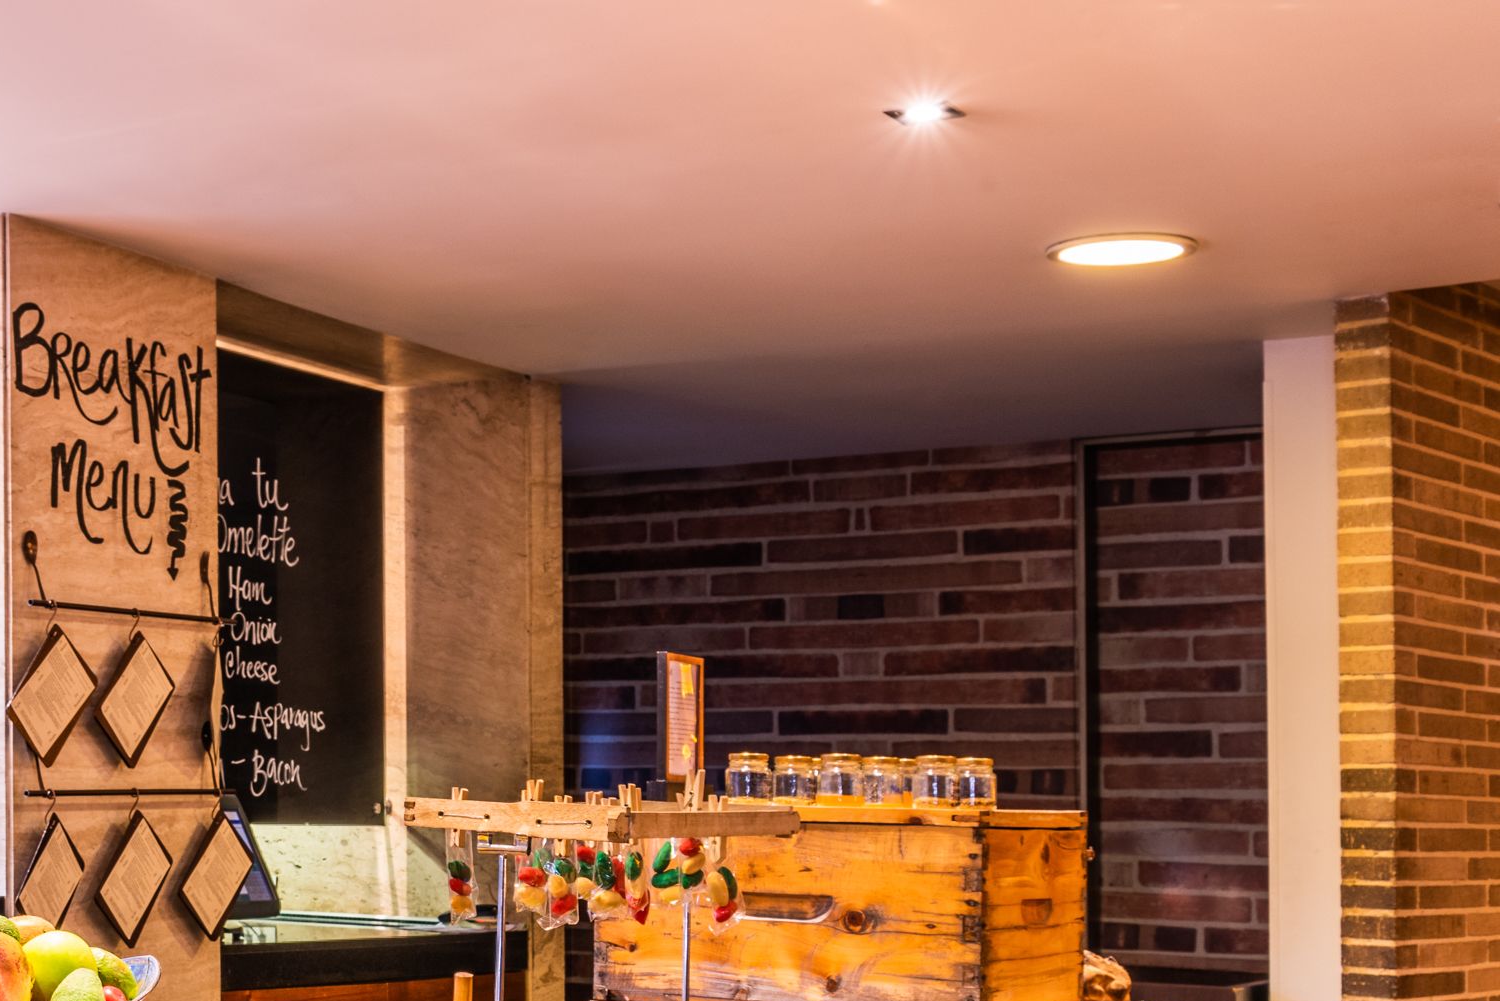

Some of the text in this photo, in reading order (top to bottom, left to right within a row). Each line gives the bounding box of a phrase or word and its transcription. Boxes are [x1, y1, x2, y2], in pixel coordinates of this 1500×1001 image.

[13, 302, 212, 476] Breakfast
[51, 439, 156, 555] Menu
[251, 457, 289, 511] tu
[228, 565, 273, 611] Ham
[225, 645, 280, 685] Cheese
[250, 748, 308, 797] Bacon
